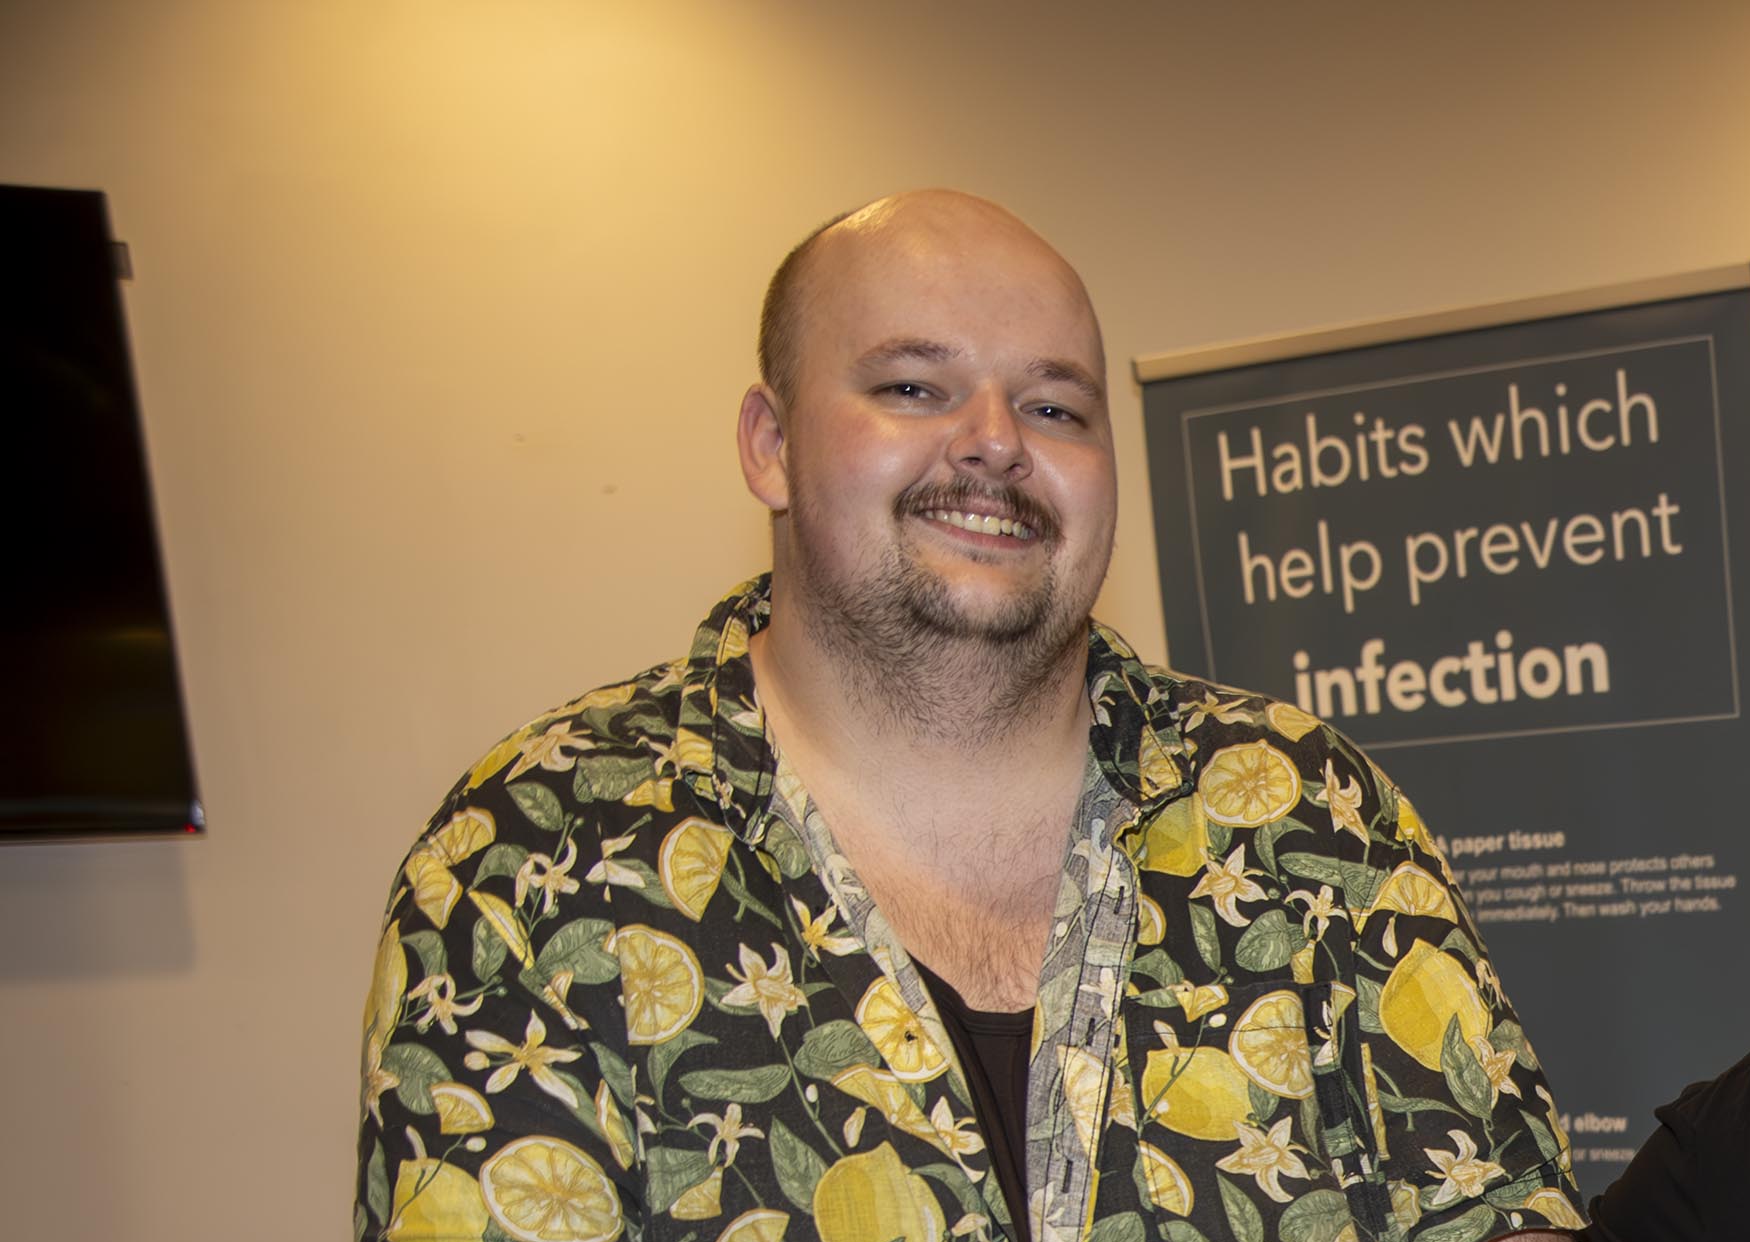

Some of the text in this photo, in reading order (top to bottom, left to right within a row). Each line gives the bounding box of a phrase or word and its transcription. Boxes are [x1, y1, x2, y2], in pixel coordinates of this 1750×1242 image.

[1218, 368, 1659, 501] Habits which
[1238, 493, 1683, 613] help prevent
[1293, 630, 1611, 719] infection
[1451, 835, 1504, 858] paper
[1508, 829, 1566, 850] tissue
[1468, 867, 1498, 884] your
[1500, 863, 1544, 879] mouth
[1547, 861, 1571, 877] and
[1573, 860, 1605, 875] nose
[1609, 855, 1668, 877] protects
[1670, 853, 1715, 870] others
[1476, 889, 1502, 905] you
[1504, 885, 1546, 903] cough
[1548, 885, 1564, 898] or
[1565, 881, 1616, 897] sneeze.
[1620, 877, 1666, 893] Throw
[1669, 876, 1692, 891] the
[1695, 874, 1737, 890] tissue
[1563, 902, 1597, 917] Then
[1600, 899, 1636, 916] wash
[1640, 899, 1672, 917] your
[1675, 896, 1722, 912] hands.
[1573, 1112, 1627, 1133] elbow
